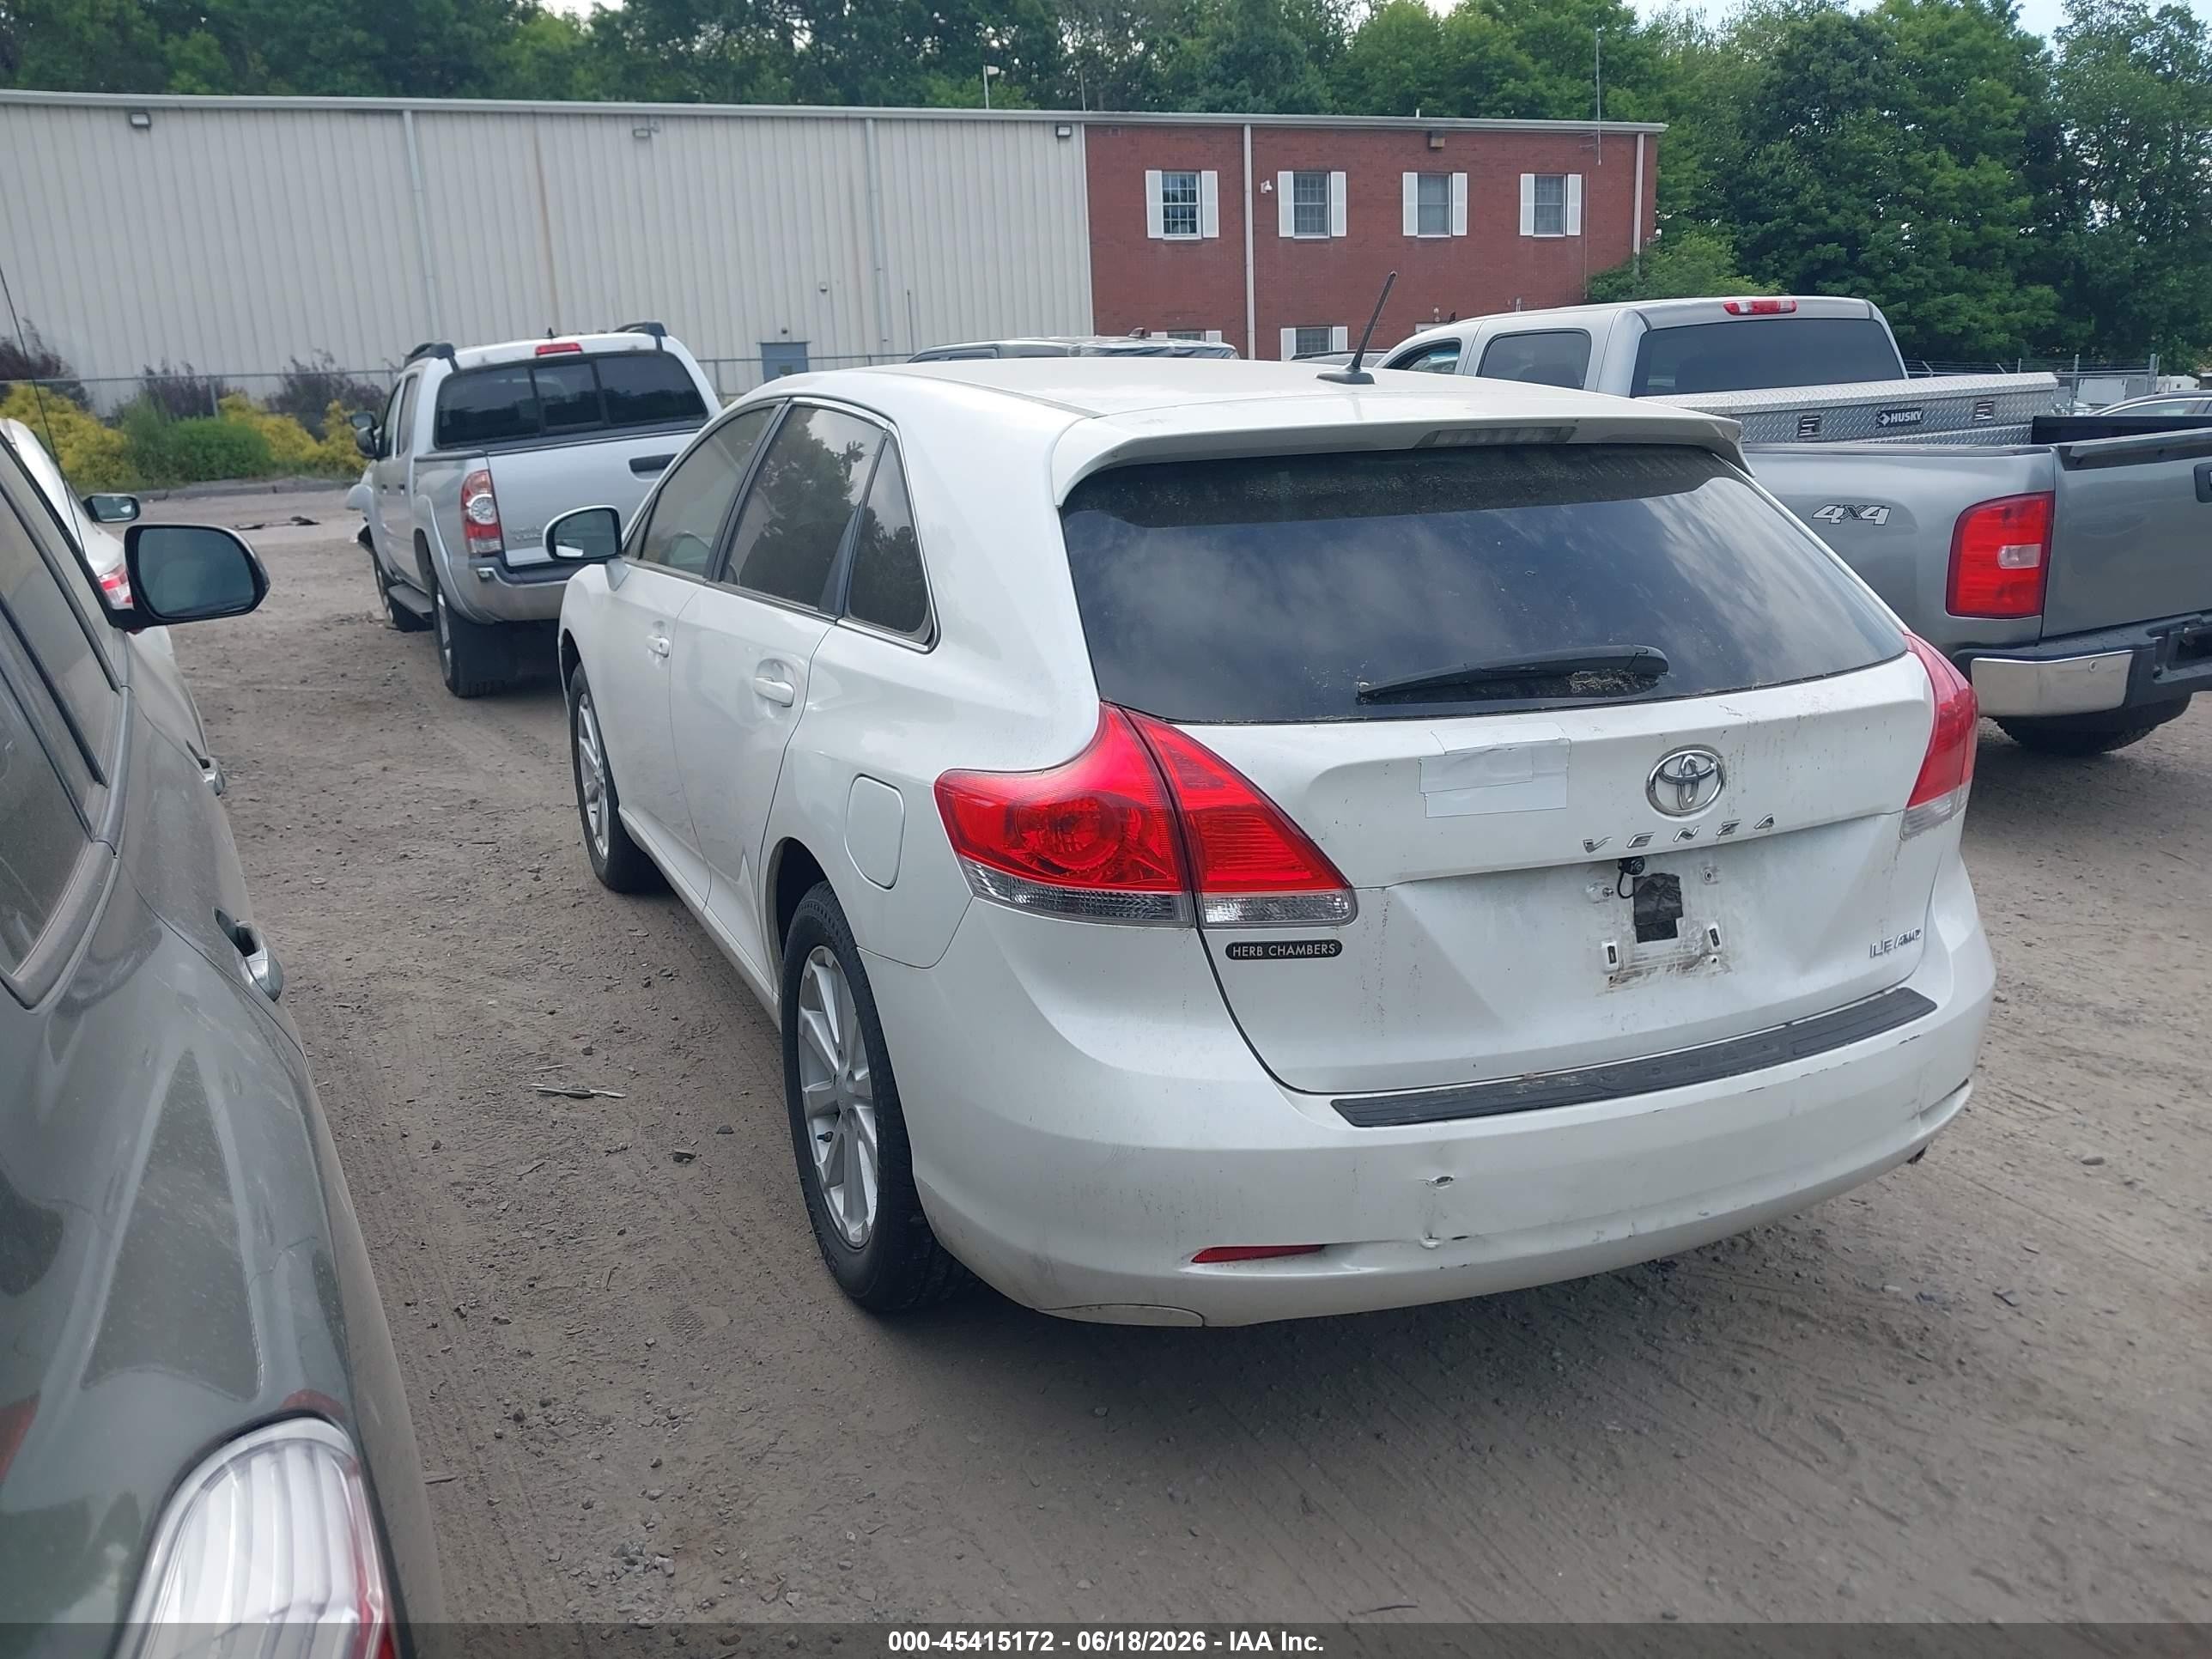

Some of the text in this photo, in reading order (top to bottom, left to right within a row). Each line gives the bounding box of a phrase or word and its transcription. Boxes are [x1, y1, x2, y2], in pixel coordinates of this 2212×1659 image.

[1890, 410, 1923, 422] HUSKY
[1583, 814, 1775, 854] VENZA
[1232, 943, 1336, 957] HERB CHAMBERS
[1869, 937, 1893, 958] LE
